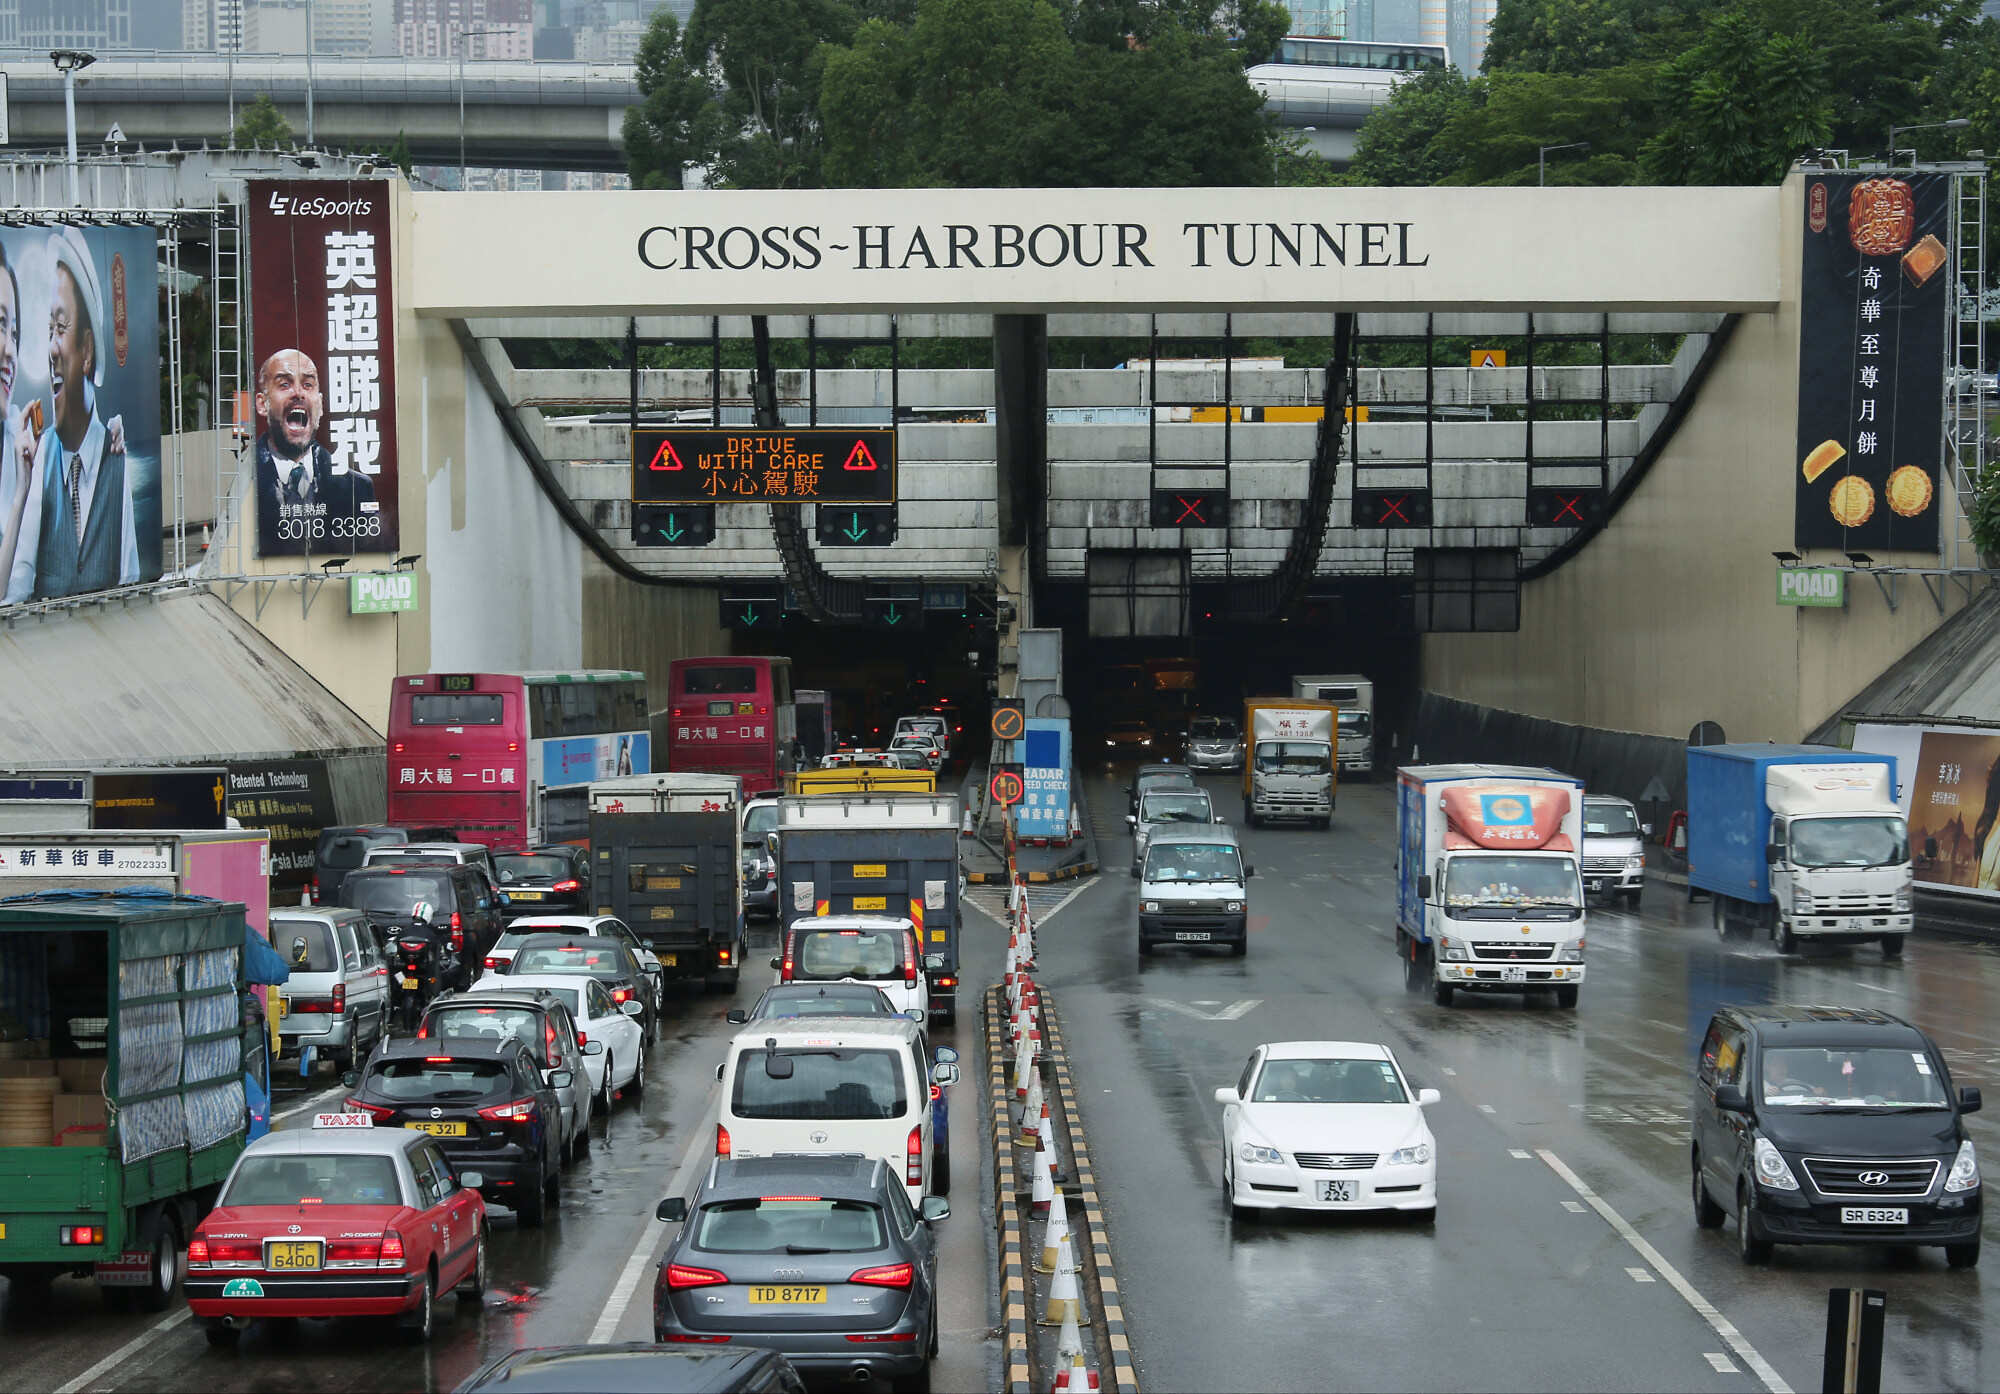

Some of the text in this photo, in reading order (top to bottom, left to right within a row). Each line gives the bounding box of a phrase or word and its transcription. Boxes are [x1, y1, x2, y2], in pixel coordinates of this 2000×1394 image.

[291, 198, 372, 218] LeSports
[1184, 223, 1429, 267] TUNNEL
[325, 231, 380, 475] 英超睇我
[1857, 266, 1882, 455] 奇華至尊月餅
[727, 438, 796, 454] DRIVE
[698, 454, 824, 470] WITH CARE
[702, 471, 820, 496] 小心駕駛
[279, 504, 328, 517] 銷售熱線
[278, 516, 380, 540] 3018 3388
[358, 576, 411, 601] POAD
[1781, 572, 1838, 597] POAD
[446, 677, 470, 690] 109
[230, 771, 309, 788] Patented Technology
[400, 768, 515, 784] 周大福 一口價
[1023, 768, 1064, 780] RADAR
[1023, 781, 1068, 790] PEED CHECK
[19, 849, 115, 867] 新華街車
[118, 860, 167, 869] 27022333
[320, 1115, 367, 1126] TAXI
[436, 1124, 456, 1134] 321
[1328, 1181, 1345, 1191] EV
[1324, 1191, 1349, 1201] 225
[1846, 1211, 1903, 1222] SR 6324
[285, 1244, 305, 1254] TF
[274, 1255, 315, 1267] 6400
[755, 1288, 820, 1301] TD 8717
